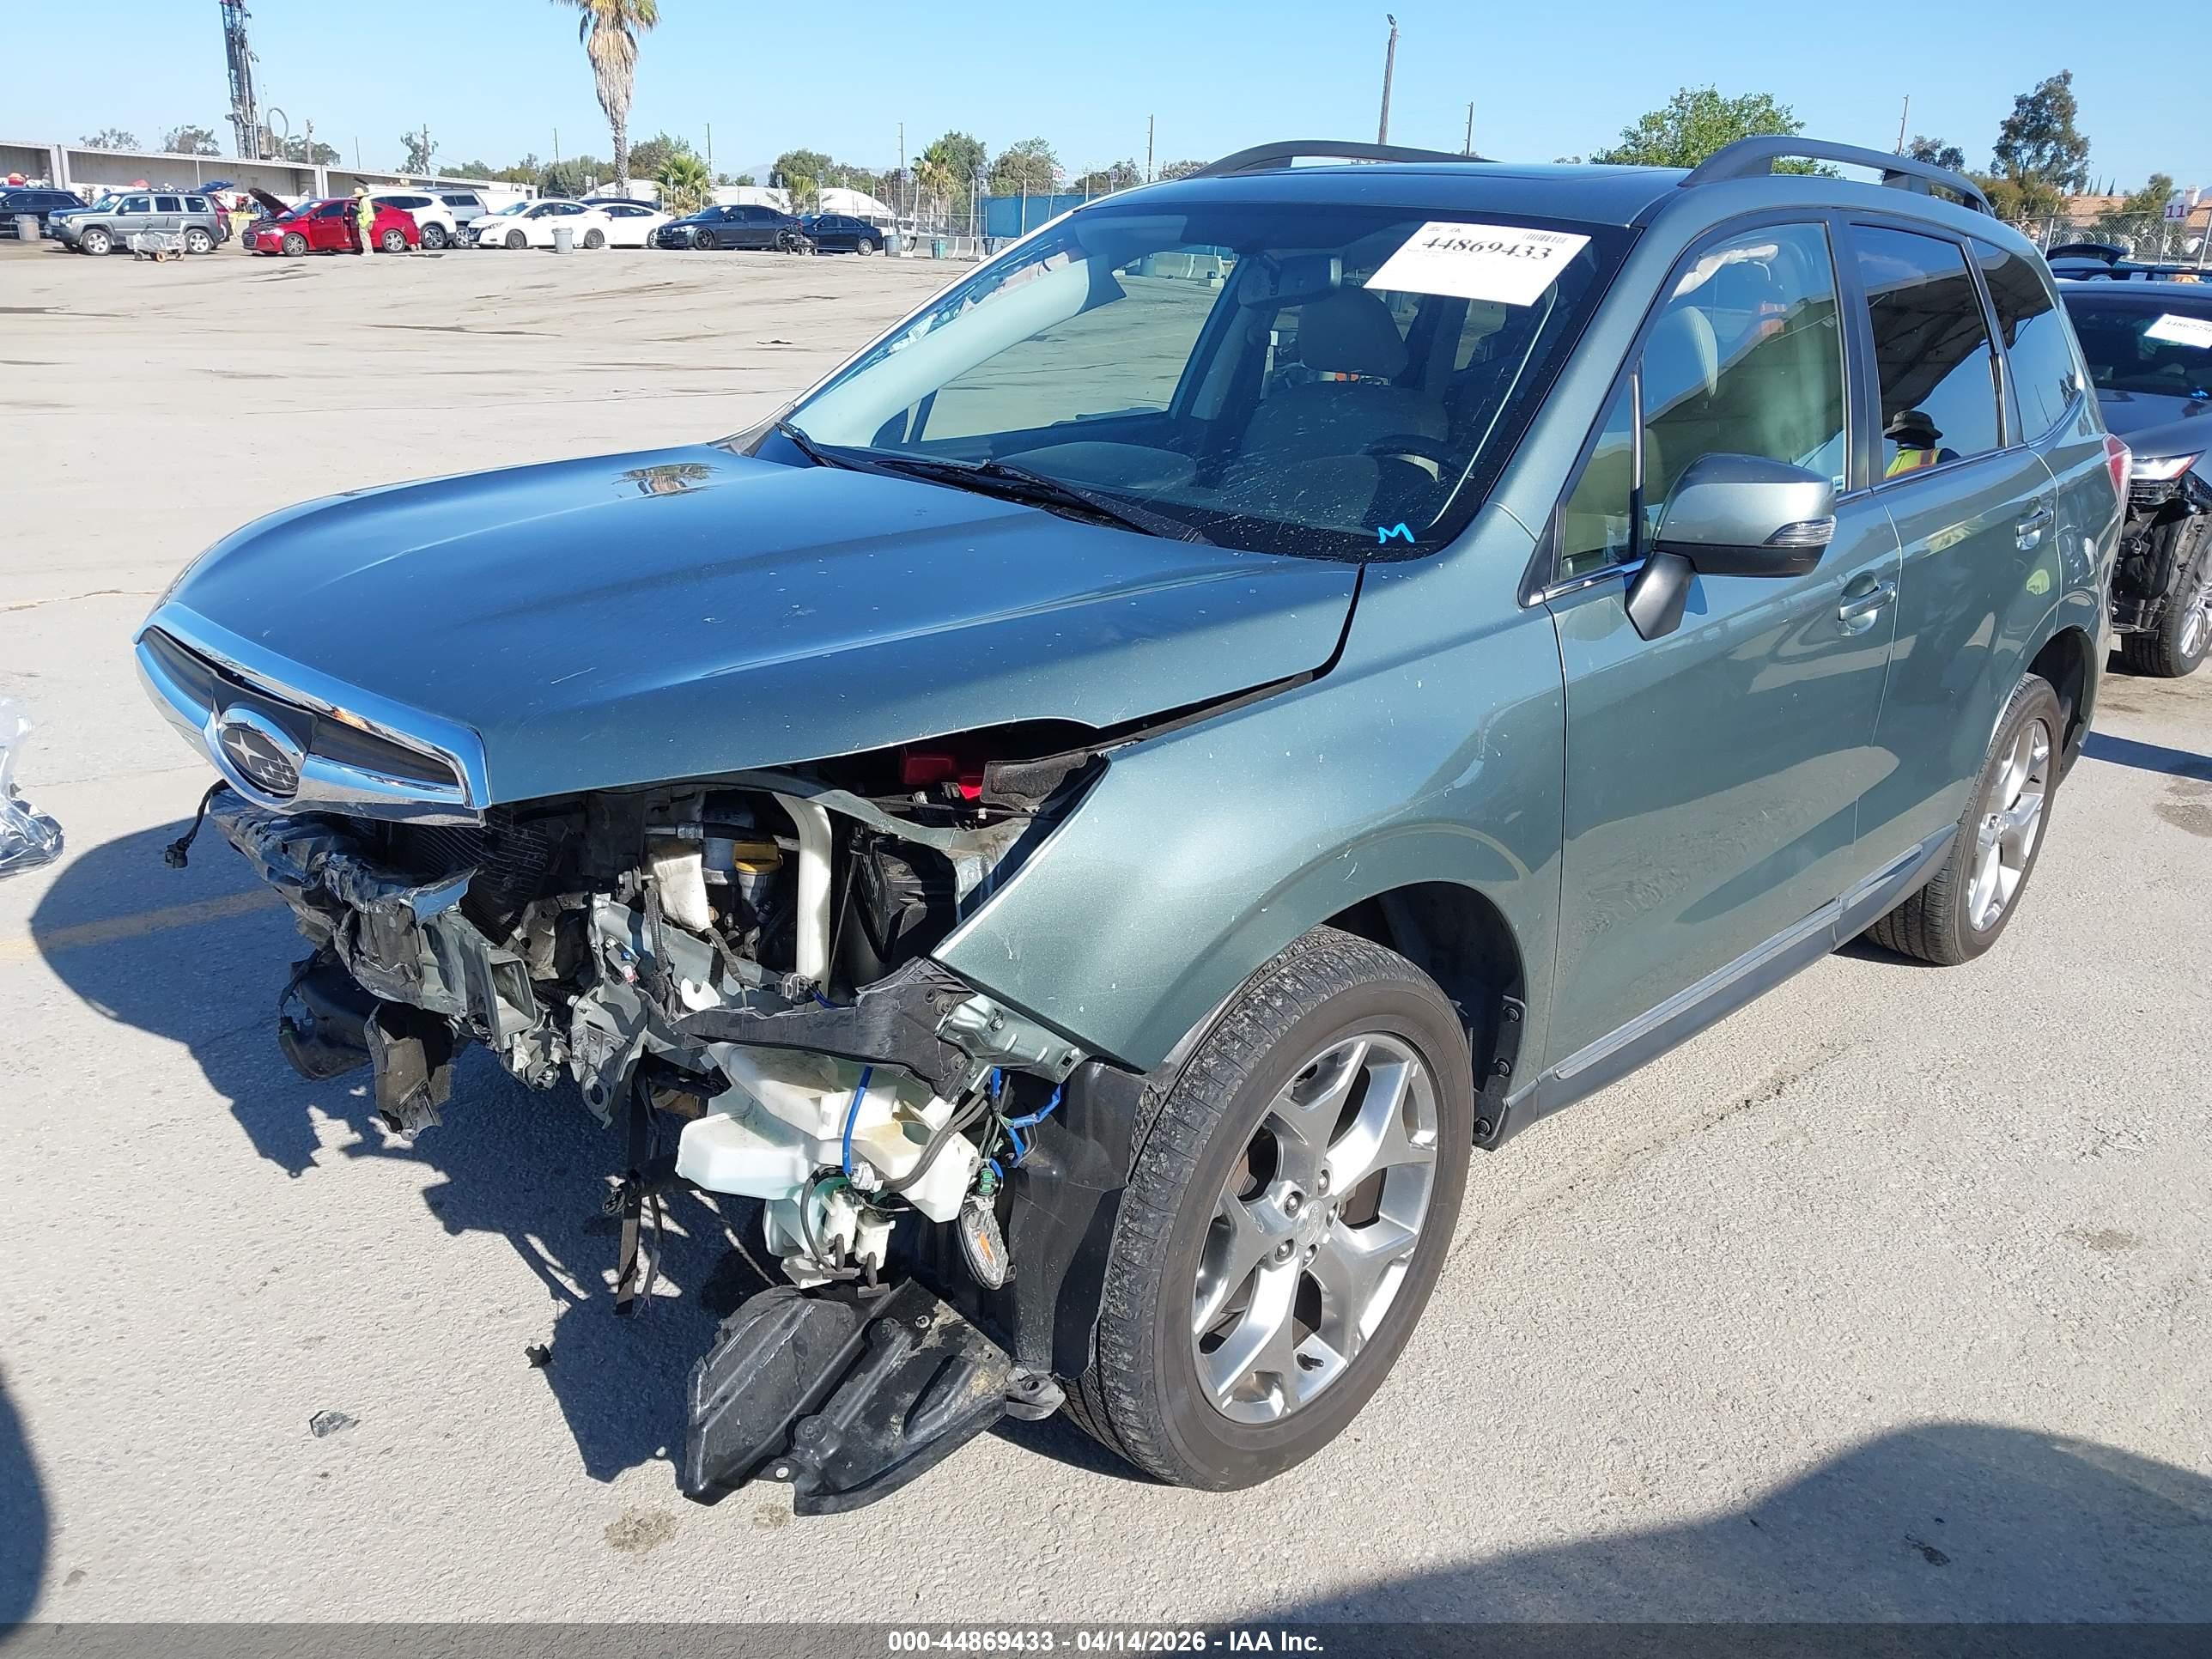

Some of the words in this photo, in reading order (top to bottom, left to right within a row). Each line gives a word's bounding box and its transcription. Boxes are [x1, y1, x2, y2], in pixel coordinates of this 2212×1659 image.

[2165, 204, 2185, 218] 11
[1422, 237, 1553, 260] 44869433
[1377, 522, 1415, 544] M
